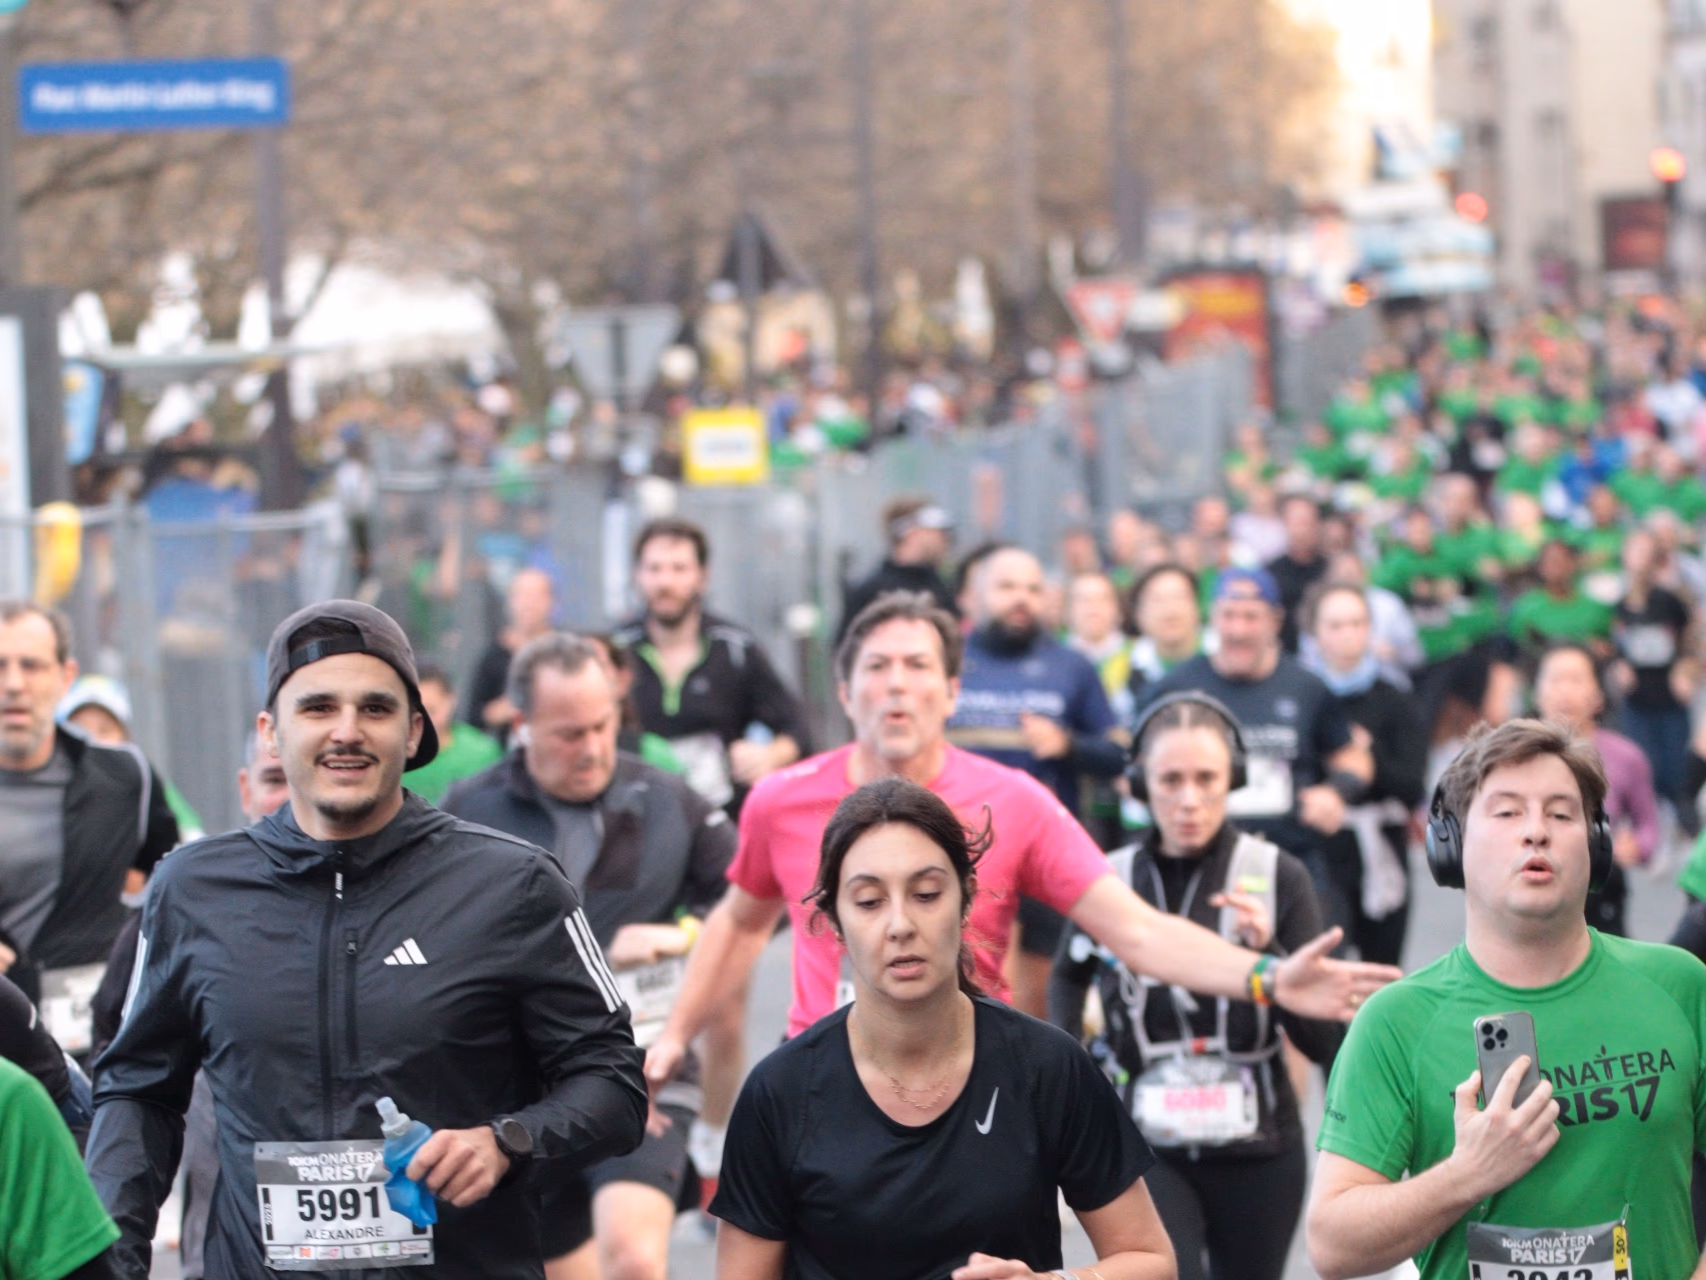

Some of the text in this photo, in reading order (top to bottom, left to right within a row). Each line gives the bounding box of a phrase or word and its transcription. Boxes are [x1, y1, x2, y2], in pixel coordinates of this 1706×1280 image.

[1556, 1076, 1660, 1127] RIS17
[297, 1186, 381, 1222] 5991
[304, 1226, 385, 1240] ALEXANDRE
